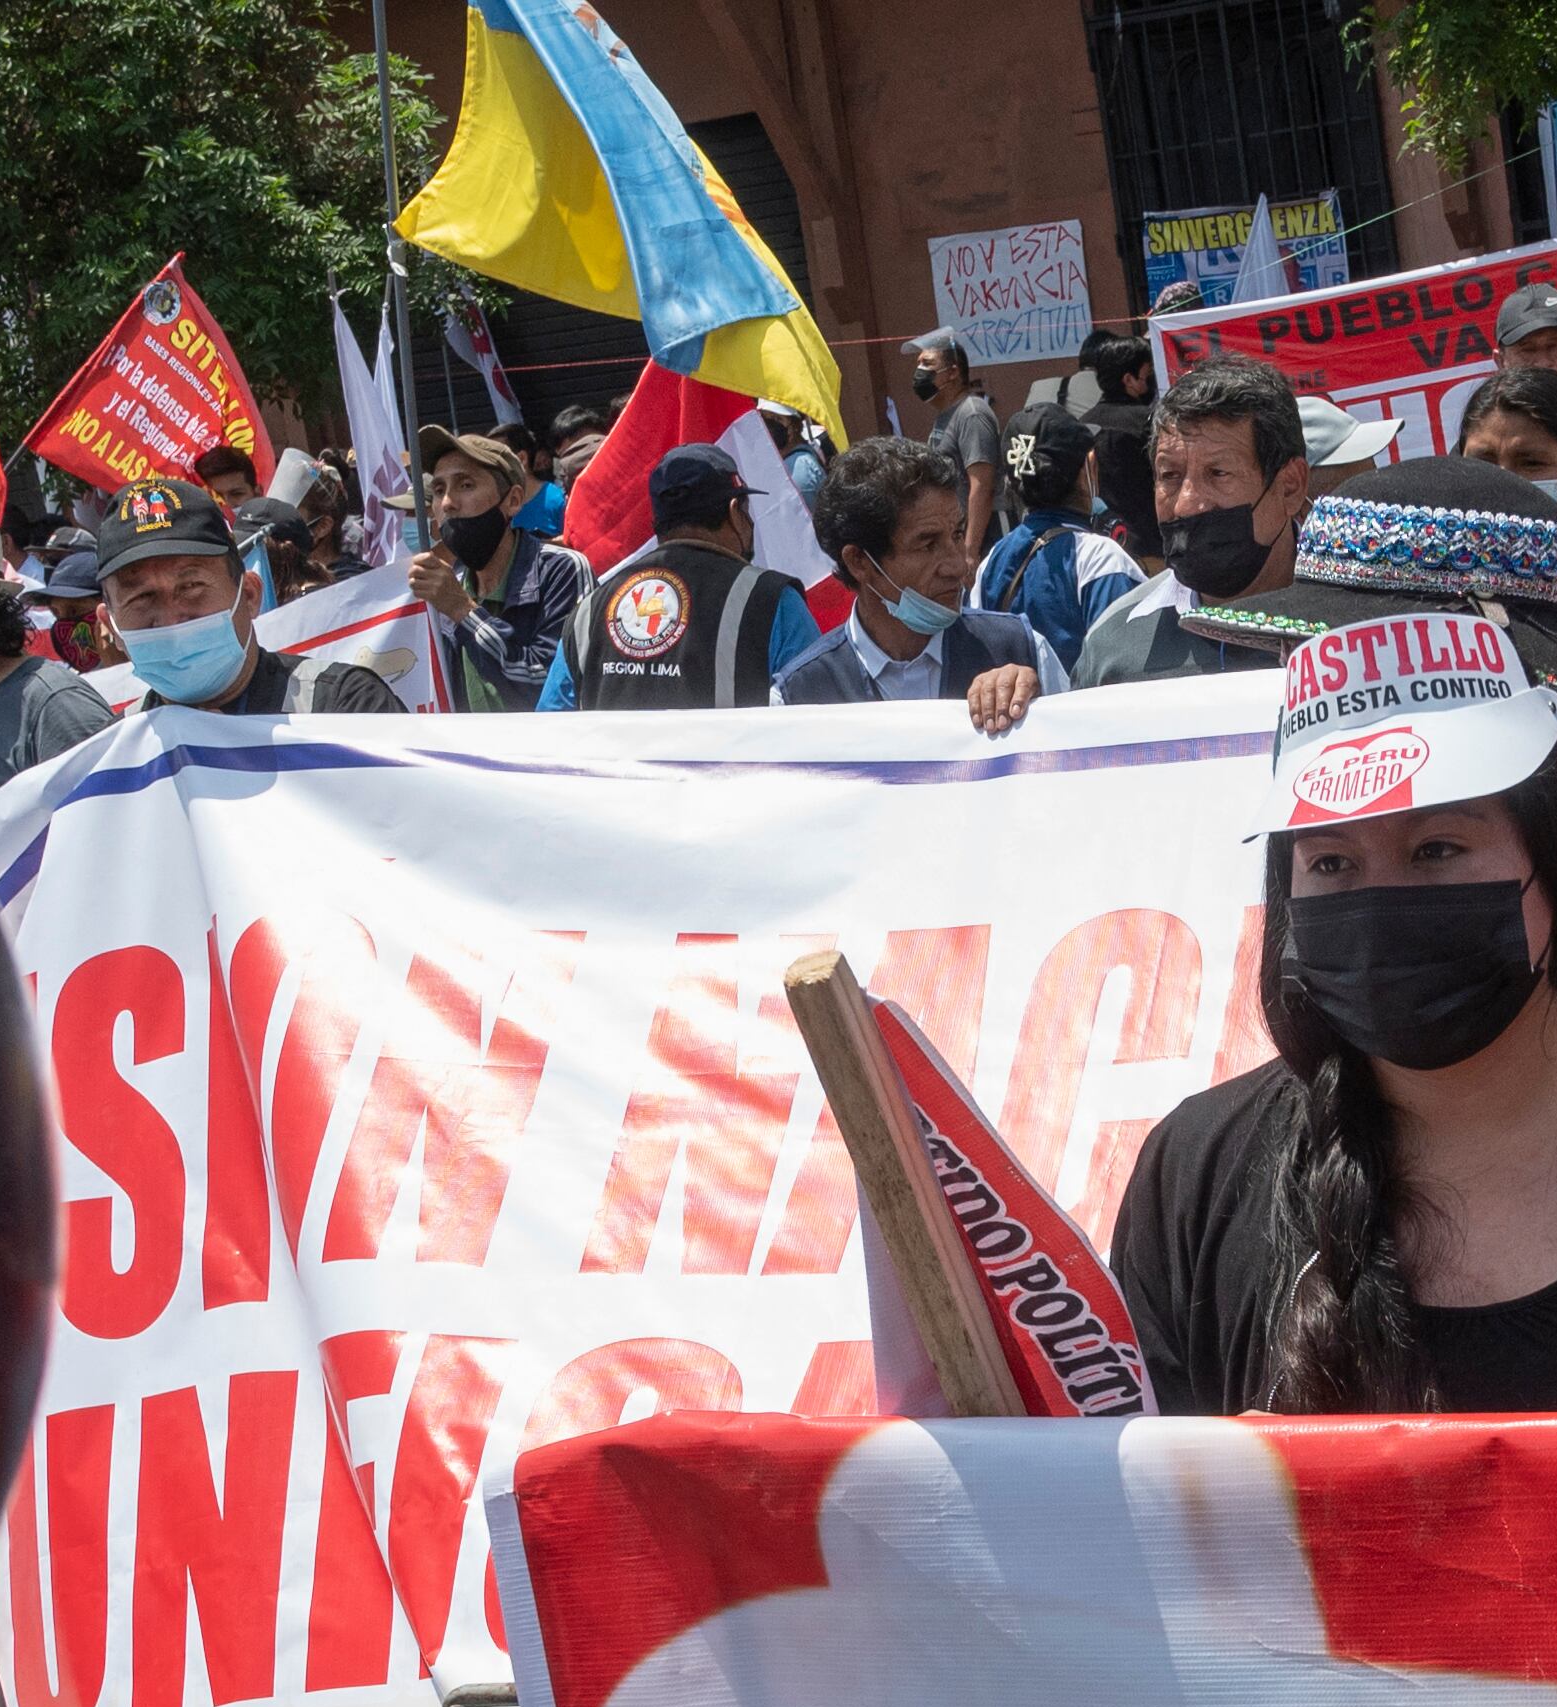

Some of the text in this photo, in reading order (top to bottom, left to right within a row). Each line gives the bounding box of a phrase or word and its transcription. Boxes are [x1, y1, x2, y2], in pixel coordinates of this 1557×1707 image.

[1147, 201, 1337, 255] SINVERGENZA
[945, 246, 976, 286] NO
[1008, 224, 1081, 264] ESTA
[1256, 274, 1494, 354] PUEBLO
[144, 334, 170, 360] BASES
[102, 343, 134, 378] ¡Por
[131, 361, 144, 389] la
[140, 373, 190, 427] defensa
[102, 391, 121, 414] y
[116, 399, 136, 422] el
[59, 407, 101, 445] ¡NO
[91, 431, 113, 459] A
[106, 432, 148, 482] LAS
[602, 661, 682, 677] REGION LIMA
[1286, 619, 1505, 711] CASTILLO
[1337, 684, 1402, 717] ESTA
[1410, 677, 1512, 702] CONTIGO
[1301, 743, 1421, 783] EL PERÚ
[1308, 761, 1404, 803] PRIMERO
